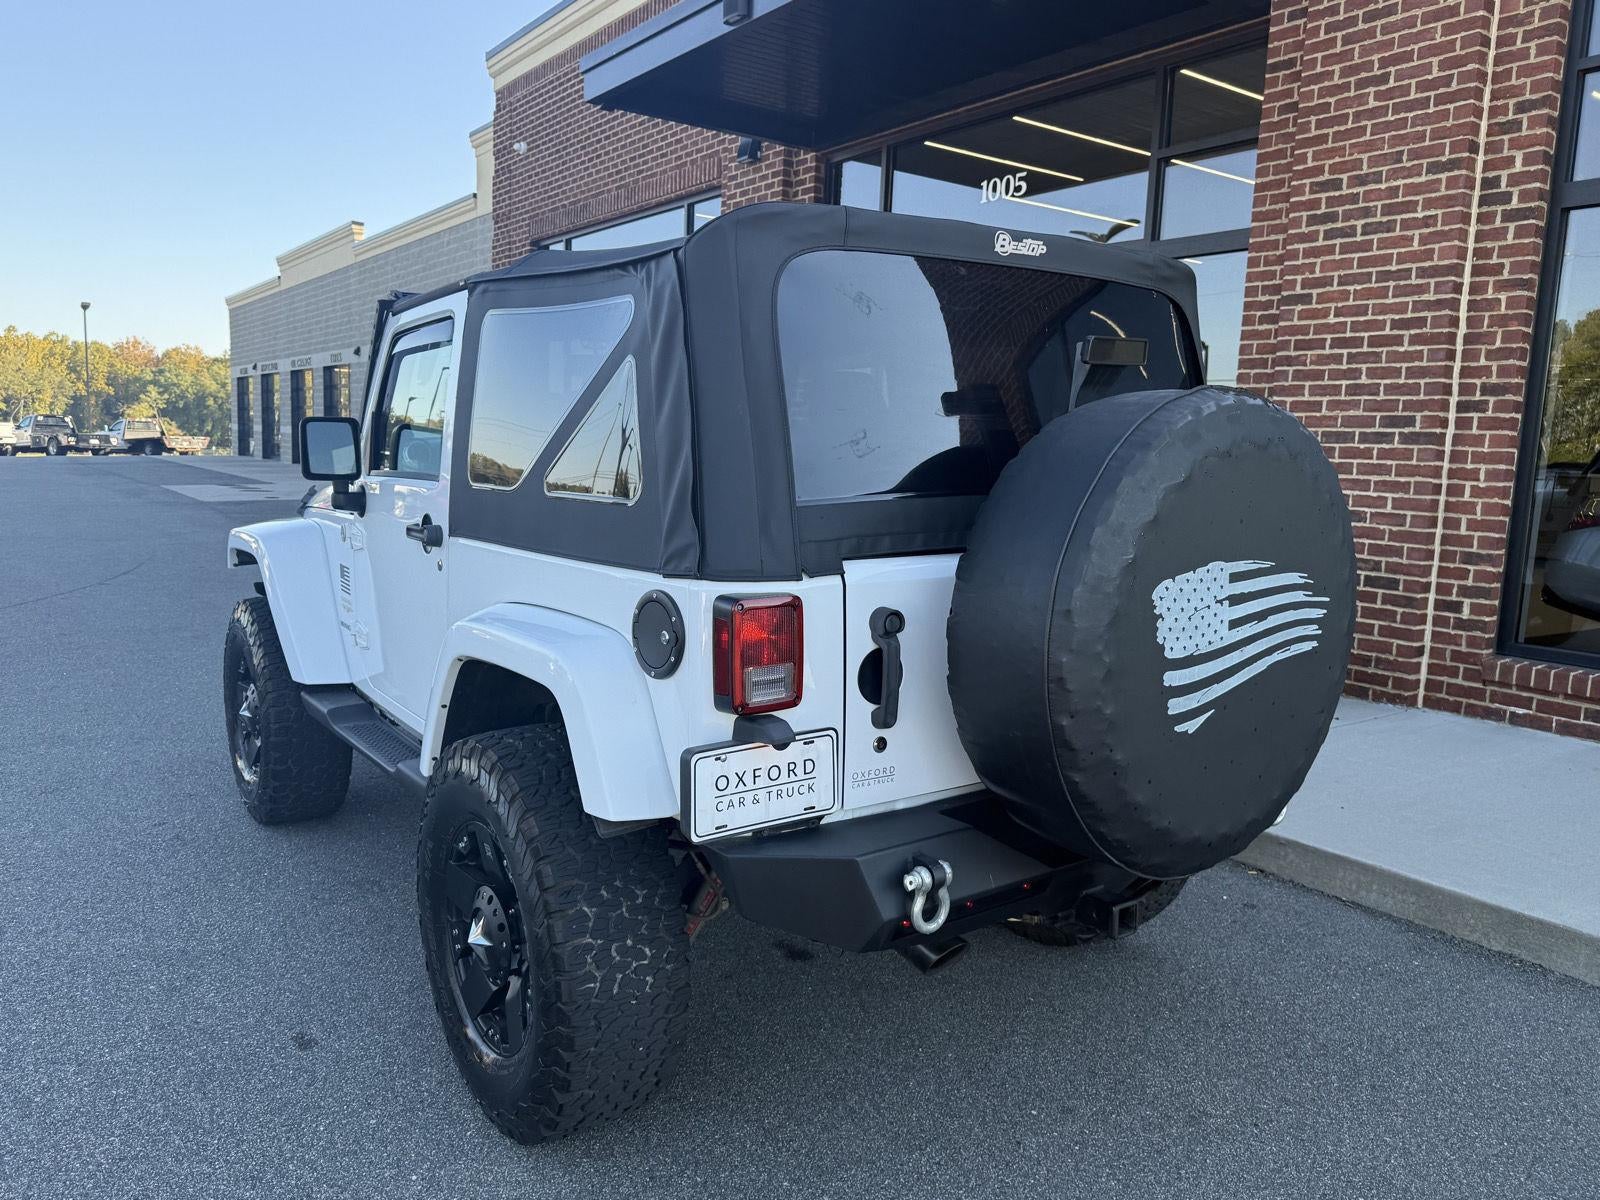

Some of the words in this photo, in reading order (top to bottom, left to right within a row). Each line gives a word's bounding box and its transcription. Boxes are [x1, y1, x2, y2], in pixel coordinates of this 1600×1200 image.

[980, 171, 1028, 204] 1005
[715, 758, 816, 792] OXFORD
[851, 765, 896, 780] OXFORD
[851, 781, 866, 789] CAR
[873, 777, 895, 786] TRUCK
[715, 796, 746, 813] CAR
[752, 793, 761, 805] &
[766, 782, 816, 802] TRUCK
